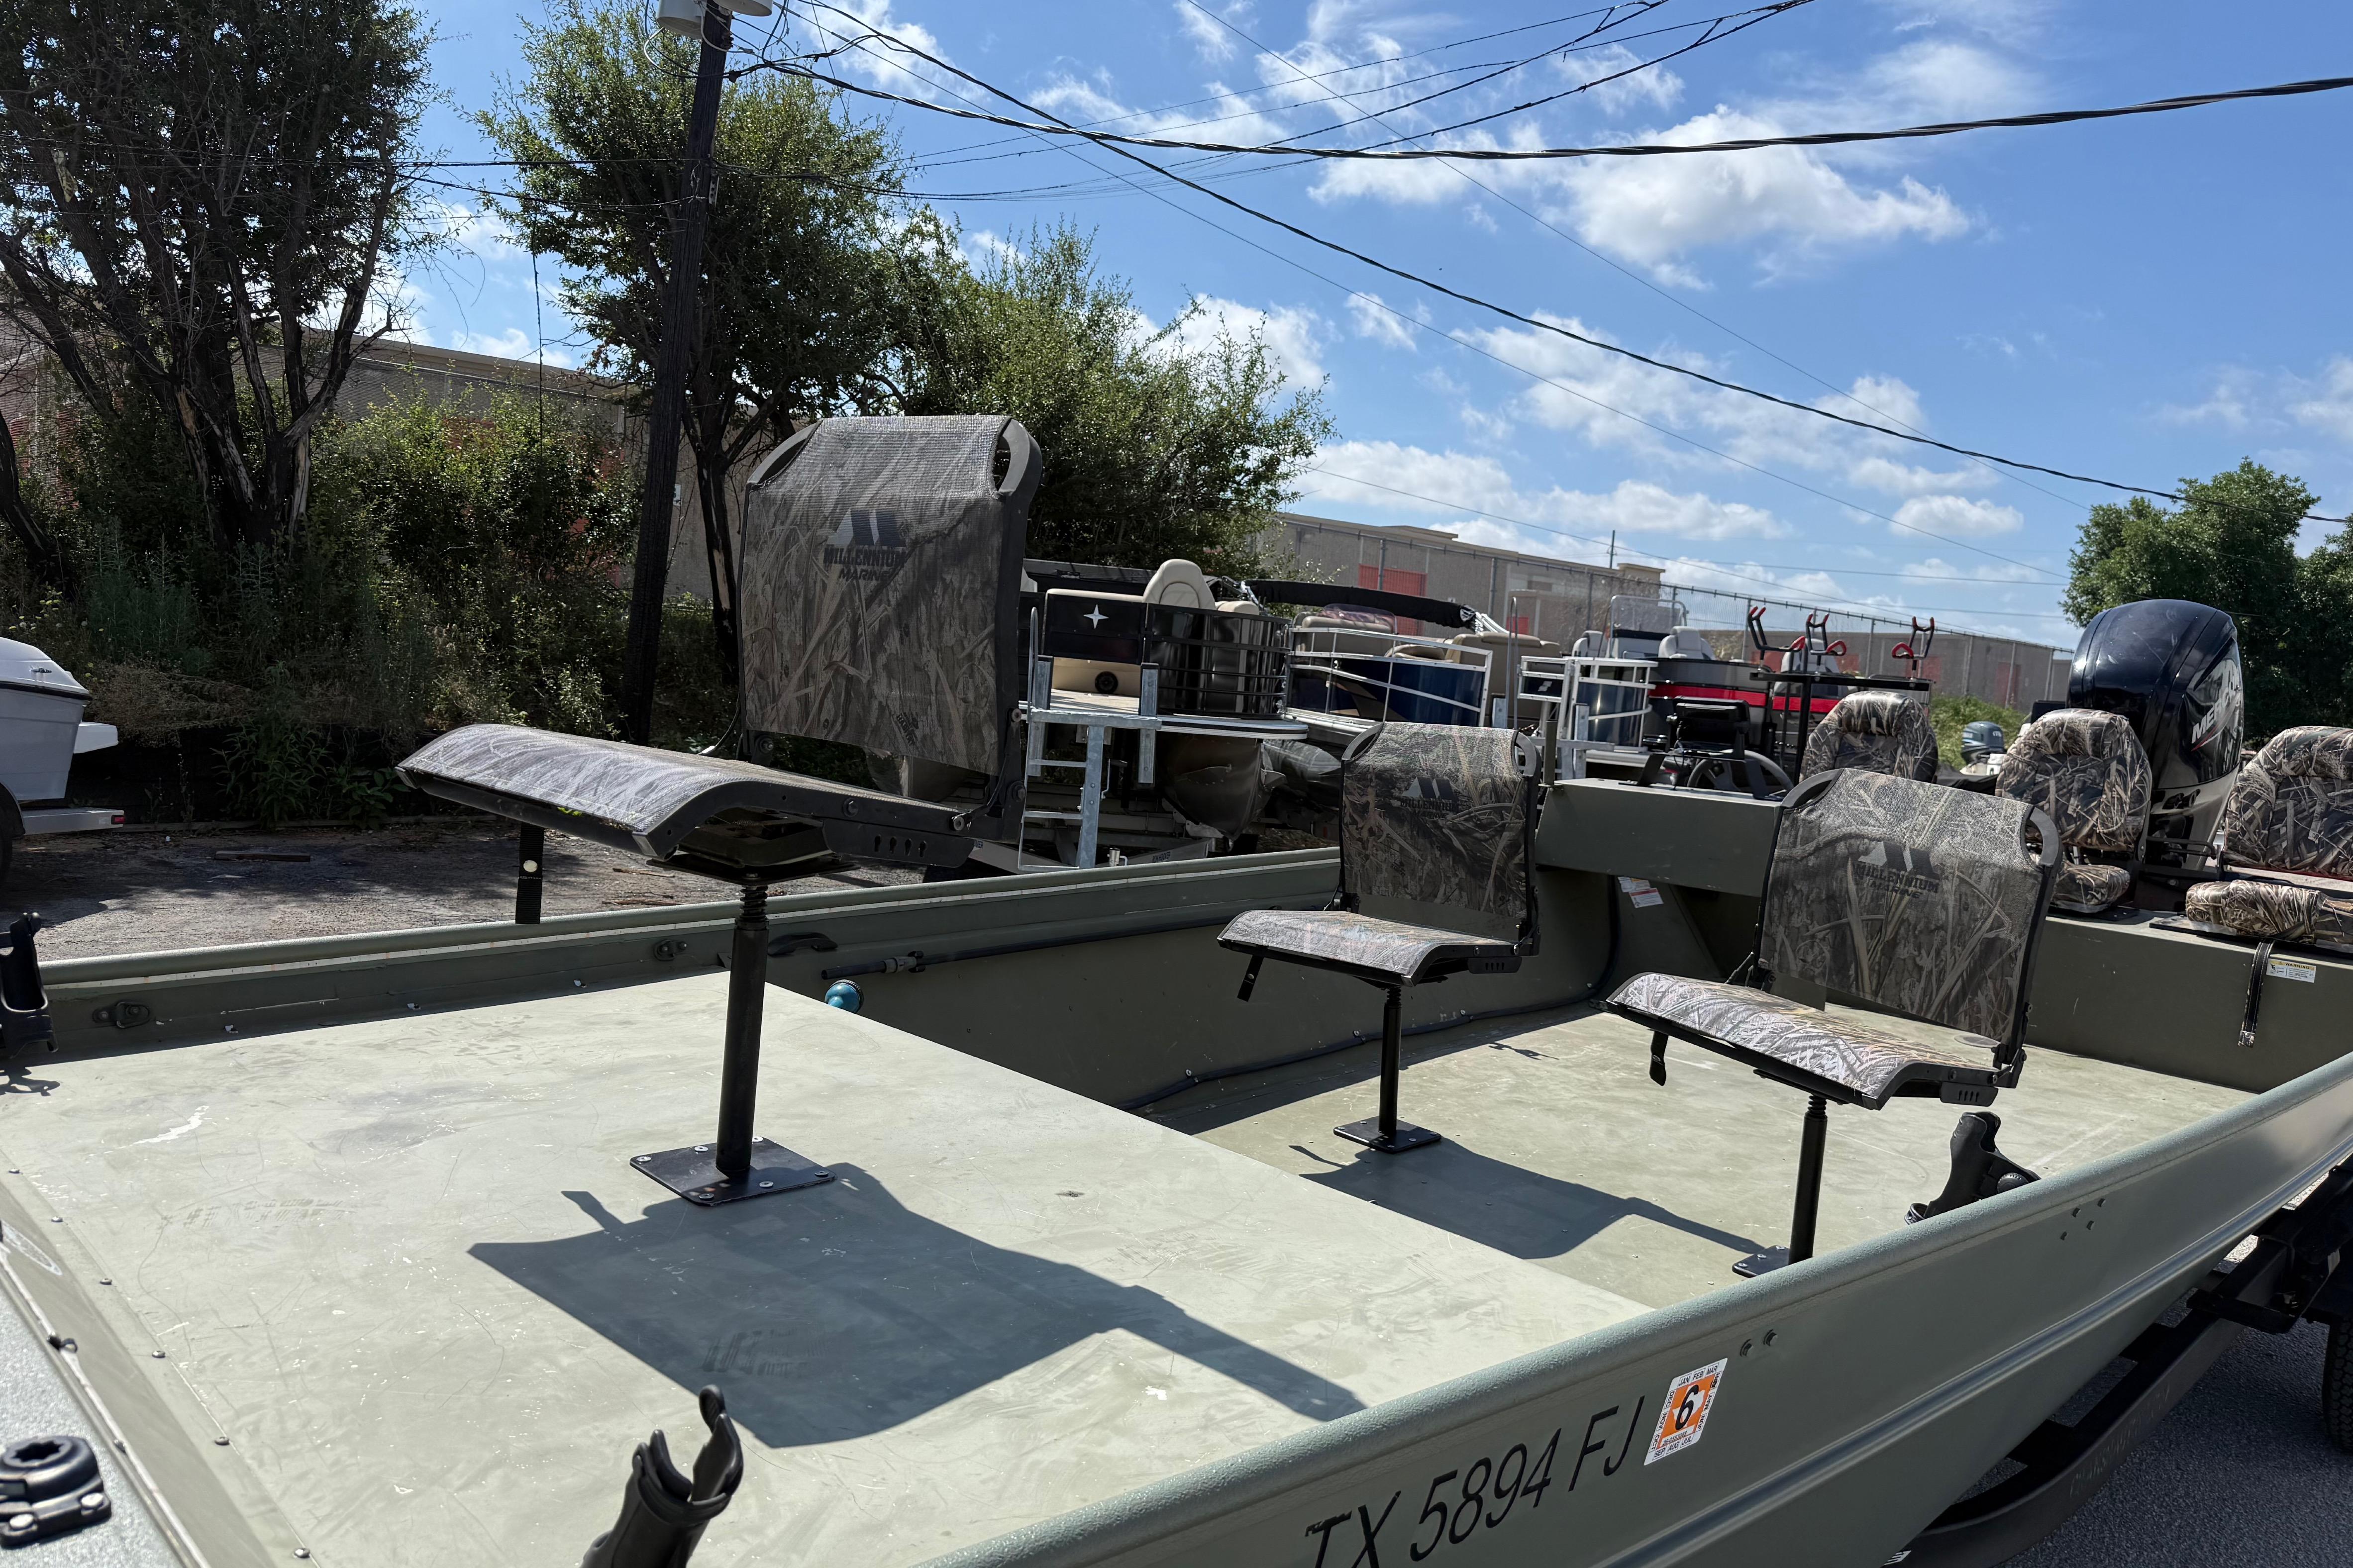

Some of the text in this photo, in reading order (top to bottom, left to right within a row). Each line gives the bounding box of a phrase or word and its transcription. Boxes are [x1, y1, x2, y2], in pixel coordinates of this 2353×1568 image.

[823, 548, 907, 568] MILLENNIUM
[1855, 863, 1939, 893] MILLENNIUM
[1678, 1366, 1718, 1386] JAN FEB MAR
[1666, 1391, 1675, 1407] DEC
[1676, 1384, 1699, 1431] 6
[1704, 1394, 1713, 1409] MAY
[1658, 1413, 1667, 1428] NOV
[1697, 1415, 1706, 1430] JUN
[1651, 1435, 1660, 1450] OCT
[1654, 1436, 1692, 1458] SEP AUG JUL
[1305, 1395, 1645, 1568] TX 5894 FJ
